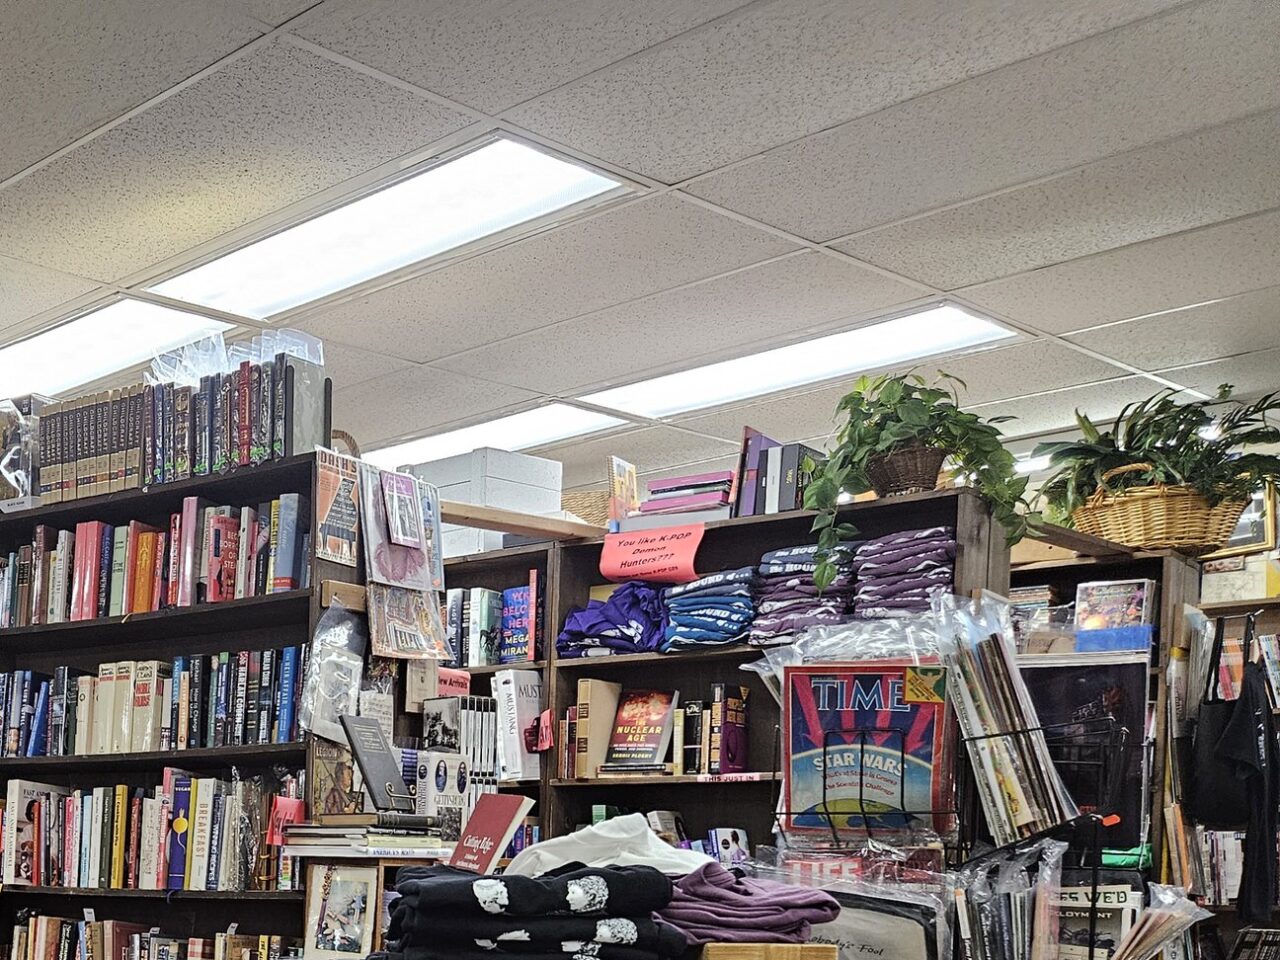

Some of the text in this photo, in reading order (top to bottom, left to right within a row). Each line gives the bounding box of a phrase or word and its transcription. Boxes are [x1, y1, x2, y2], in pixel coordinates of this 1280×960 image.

[616, 531, 692, 548] You like K-POP
[631, 545, 667, 556] Demon
[620, 552, 676, 570] Hunters???
[502, 604, 528, 617] BELO
[508, 617, 529, 630] HER
[505, 634, 530, 645] MEGA
[500, 645, 529, 657] MIRAN
[283, 662, 291, 678] HEIR
[281, 679, 290, 705] AFFAIR
[811, 678, 912, 712] TIME
[505, 692, 517, 736] MUSTANG
[616, 725, 663, 735] NUCLEAR
[627, 734, 647, 743] AGE
[813, 752, 907, 777] STAR WARS
[723, 774, 744, 782] JUST
[195, 802, 209, 859] BREAKFAST
